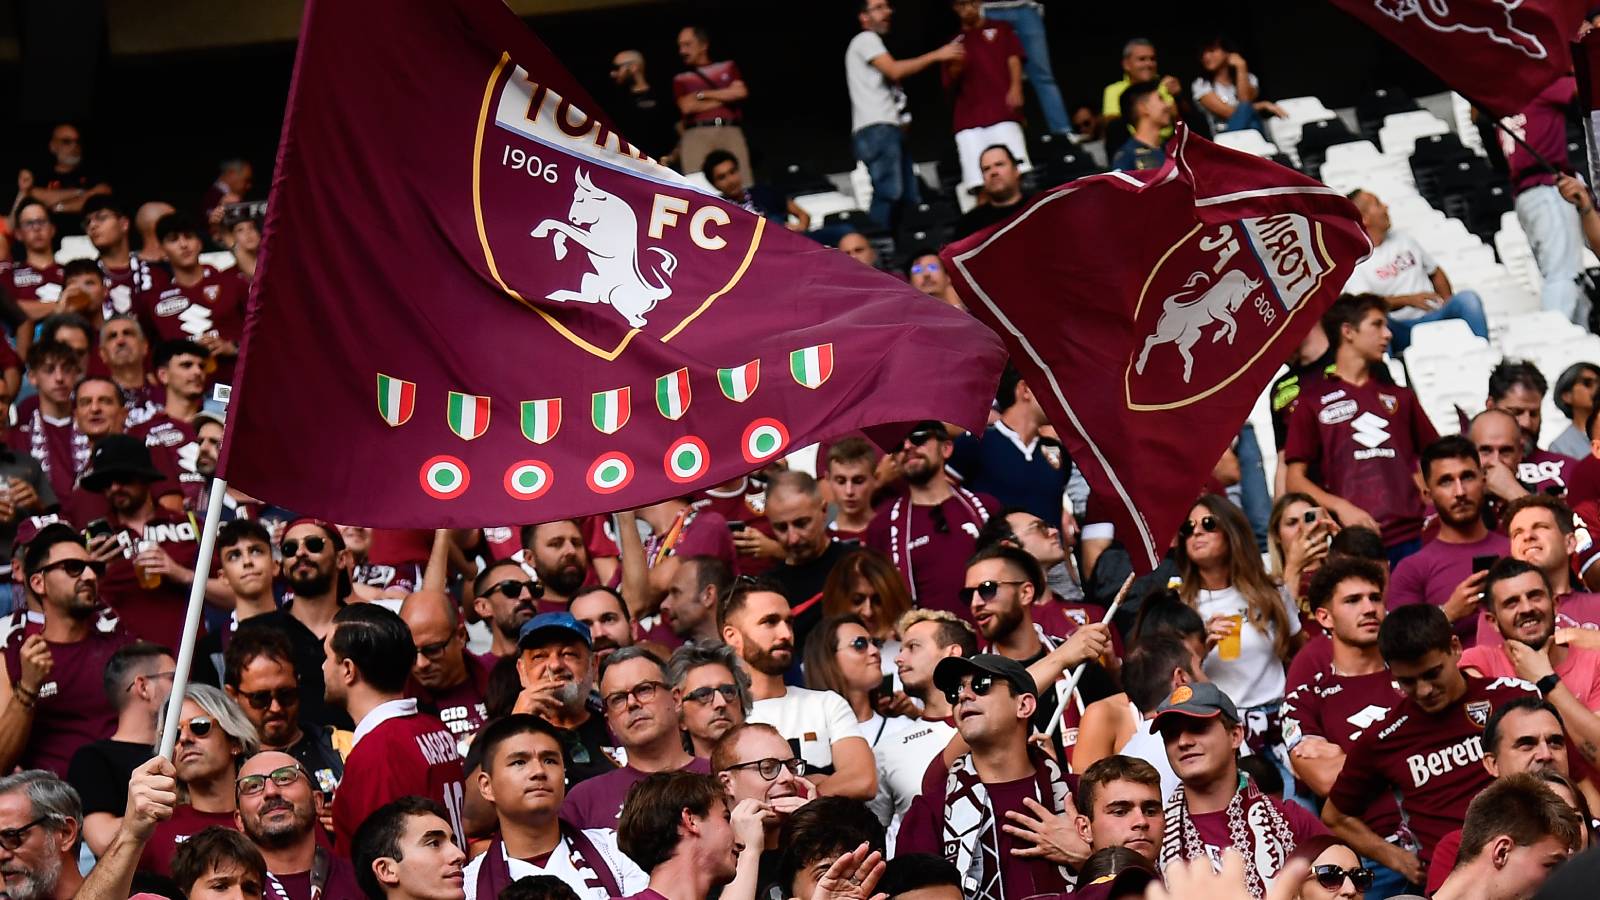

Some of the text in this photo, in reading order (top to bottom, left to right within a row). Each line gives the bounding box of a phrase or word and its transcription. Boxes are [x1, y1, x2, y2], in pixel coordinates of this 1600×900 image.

[501, 144, 558, 184] 1906
[648, 193, 731, 250] FC
[1406, 735, 1484, 788] Berett
